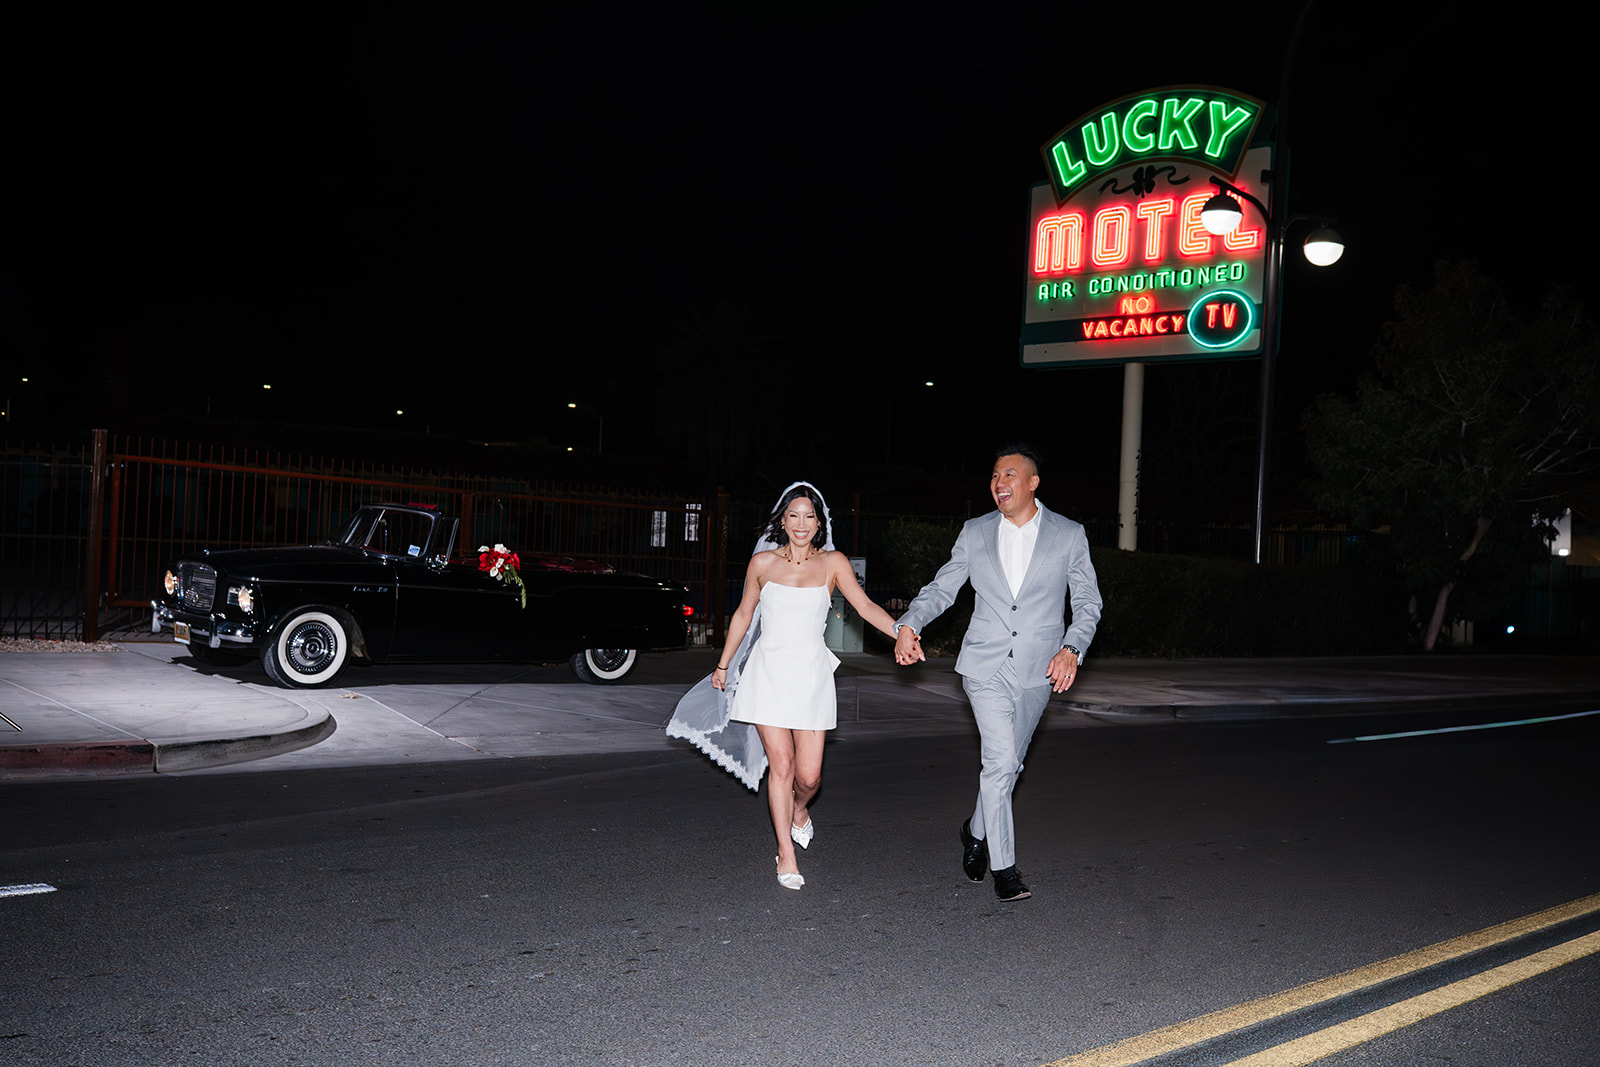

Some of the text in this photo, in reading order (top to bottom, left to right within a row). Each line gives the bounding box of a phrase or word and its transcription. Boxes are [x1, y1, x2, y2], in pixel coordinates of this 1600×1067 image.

[1051, 97, 1251, 188] LUCKY
[1038, 263, 1245, 301] AIR CONDITIONED
[1121, 297, 1151, 315] NO
[1206, 303, 1237, 329] TV
[1082, 315, 1184, 340] VACANCY
